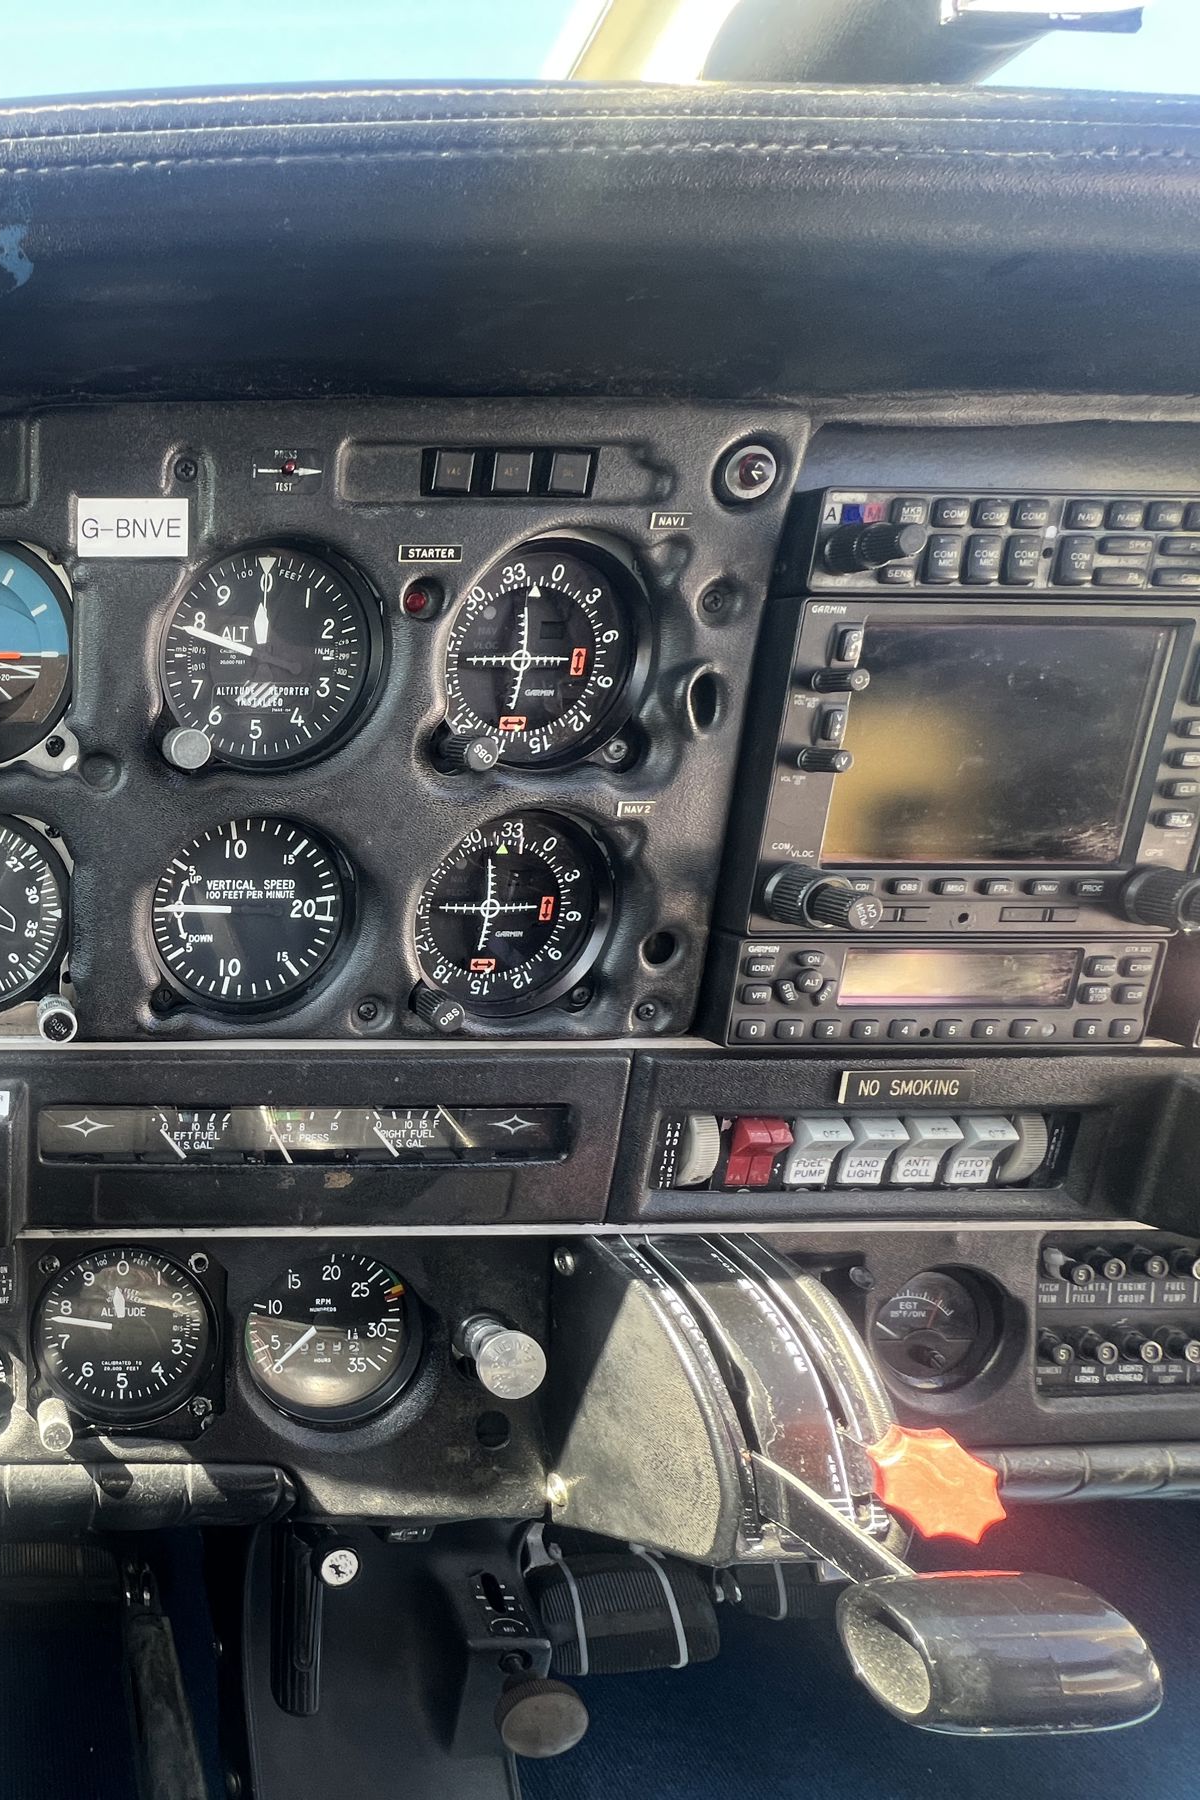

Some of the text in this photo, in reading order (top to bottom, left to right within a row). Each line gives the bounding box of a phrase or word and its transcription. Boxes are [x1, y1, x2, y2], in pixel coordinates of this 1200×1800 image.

[275, 482, 293, 491] TEST
[943, 511, 967, 519] COM1
[82, 518, 181, 538] G-BNVE
[408, 548, 455, 558] STARTER
[933, 549, 957, 559] COM1
[1071, 553, 1090, 561] COM
[502, 562, 526, 585] 33
[465, 586, 486, 611] 30
[586, 587, 602, 604] 3
[811, 605, 847, 613] GARMIN
[221, 627, 248, 643] ALT
[321, 619, 334, 638] 2
[217, 686, 310, 696] ALTITUDE REPORTER
[316, 677, 330, 697] 3
[525, 688, 555, 697] GARMIN
[290, 707, 304, 727] 4
[569, 711, 592, 732] 12
[249, 720, 261, 740] 5
[474, 743, 493, 763] OBS
[529, 737, 552, 755] 15
[501, 821, 524, 837] 33
[461, 828, 483, 849] 30
[226, 840, 247, 859] 10
[5, 856, 25, 873] 27
[207, 880, 295, 891] VERTICAL SPEED
[900, 883, 918, 891] OBS
[1038, 884, 1058, 892] VNAV
[24, 885, 39, 904] 30
[206, 890, 294, 899] 100 FEET PER MINUTE
[291, 899, 316, 919] 20
[189, 934, 213, 943] DOWN
[495, 931, 524, 939] GARMIN
[748, 945, 780, 953] GARMIN
[220, 958, 240, 976] 10
[432, 963, 451, 984] 18
[752, 964, 775, 972] IDENT
[1095, 964, 1116, 972] FUNC
[470, 980, 491, 996] 15
[512, 971, 534, 989] 12
[805, 977, 820, 986] ALT
[752, 992, 767, 1000] VFR
[782, 983, 795, 1002] STBY
[440, 1007, 461, 1026] OBS
[857, 1080, 958, 1096] NO SMOKING
[191, 1123, 200, 1131] 10
[381, 1130, 434, 1138] RIGHT FUEL
[168, 1132, 220, 1141] LEFT FUEL
[849, 1160, 878, 1168] LAND
[905, 1160, 929, 1168] ANTI
[957, 1160, 990, 1168] PITOT
[794, 1170, 825, 1178] PUMP
[847, 1170, 880, 1178] LIGHT
[902, 1169, 929, 1178] COLL
[954, 1170, 983, 1178] HEAT
[83, 1271, 94, 1287] 9
[322, 1265, 341, 1281] 20
[1079, 1270, 1086, 1279] 5
[288, 1274, 301, 1289] 15
[351, 1282, 370, 1298] 25
[1164, 1294, 1186, 1302] PUMP
[269, 1299, 282, 1315] 10
[367, 1322, 386, 1338] 30
[82, 1361, 94, 1378] 6
[347, 1357, 366, 1373] 35
[117, 1373, 128, 1389] 5
